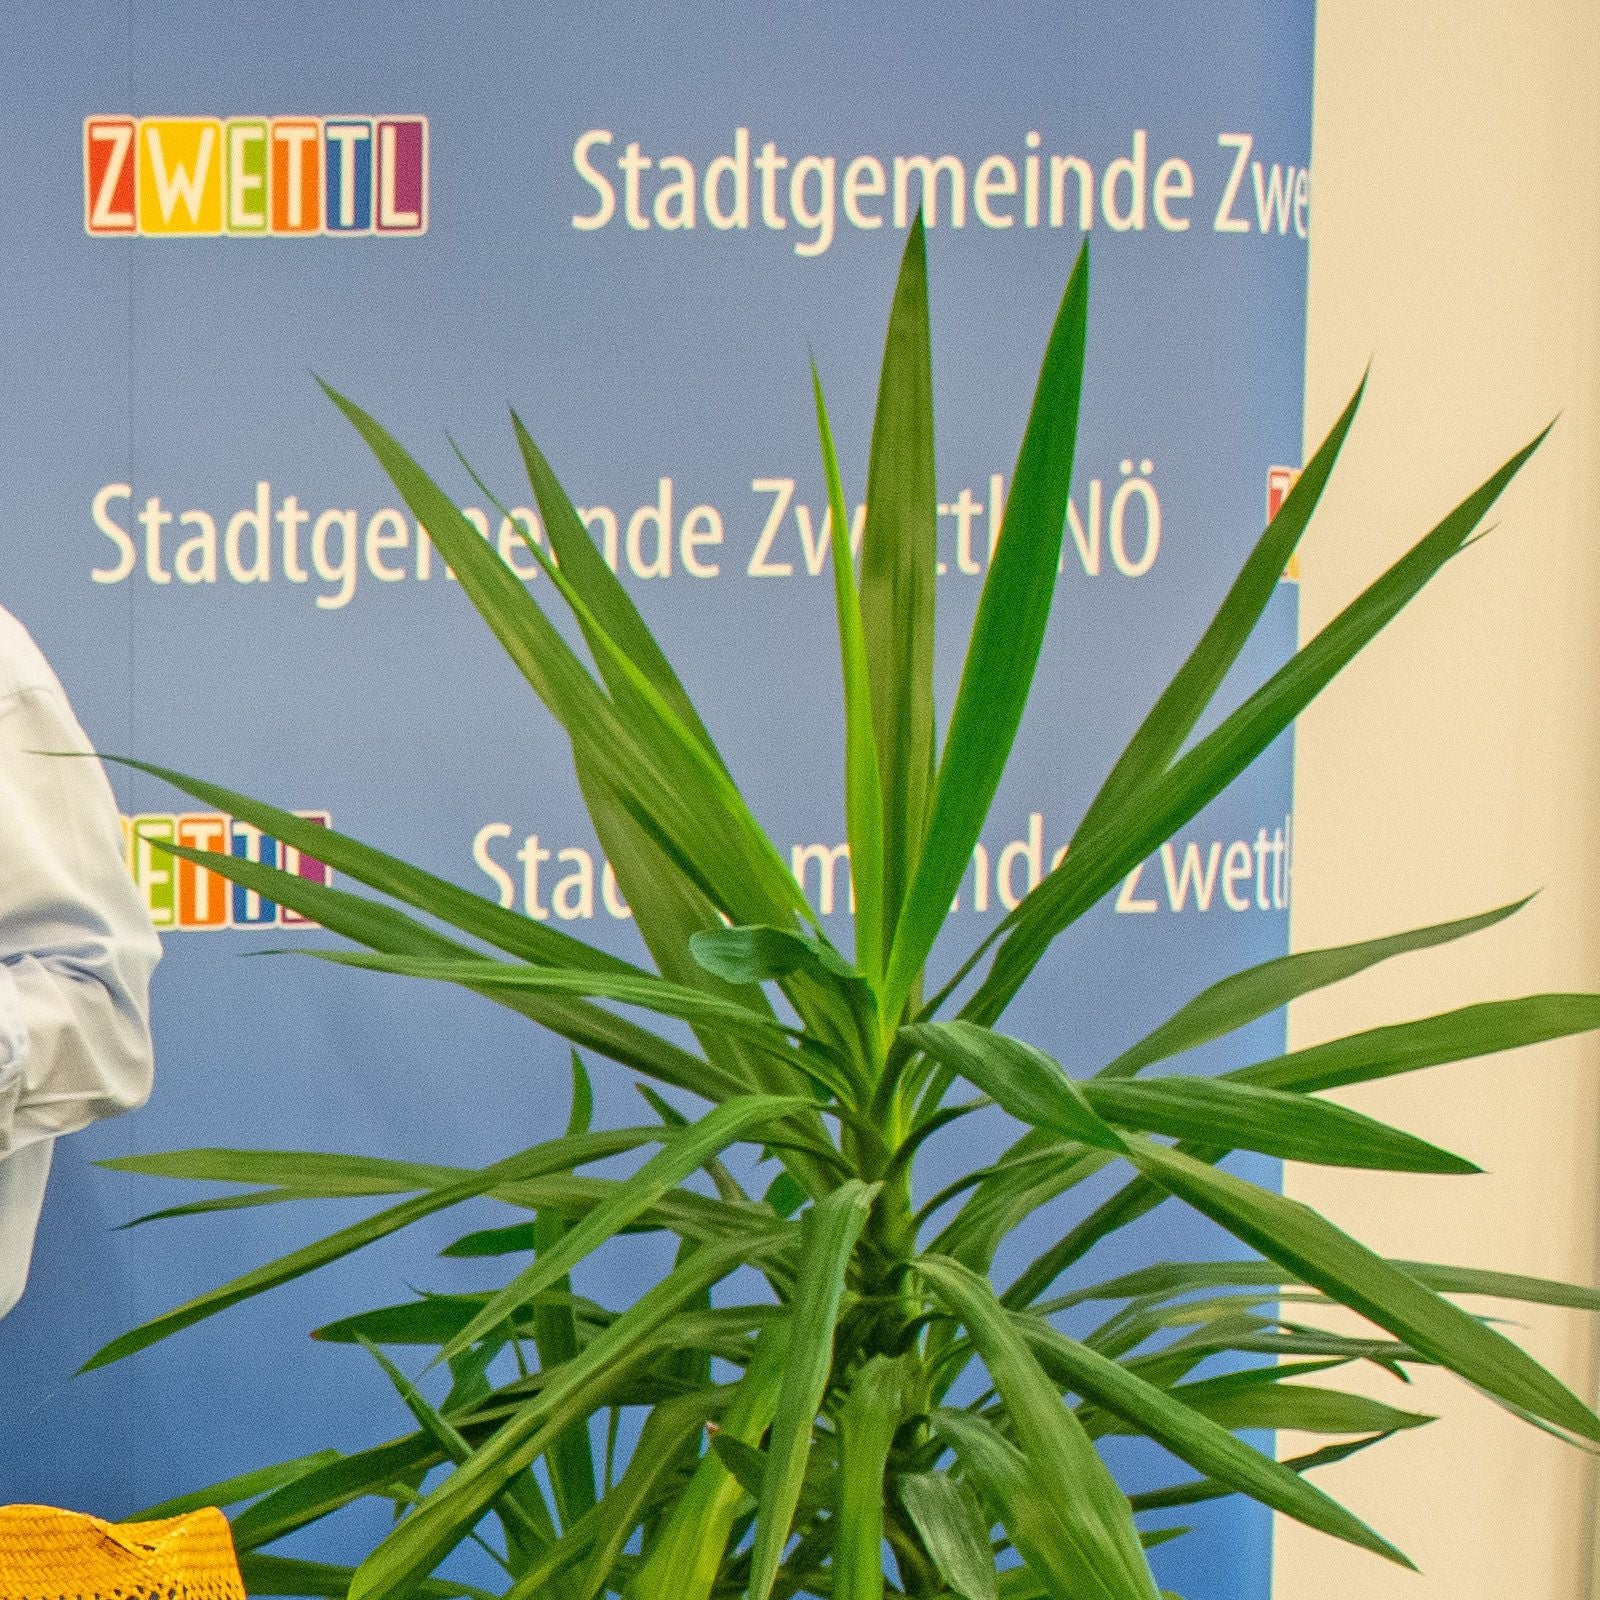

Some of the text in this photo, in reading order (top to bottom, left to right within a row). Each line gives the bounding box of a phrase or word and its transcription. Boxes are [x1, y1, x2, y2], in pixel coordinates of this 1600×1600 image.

[90, 123, 418, 232] ZWETTL
[571, 127, 1193, 257] Stadtgemeinde
[91, 476, 725, 610] Stadtgeende
